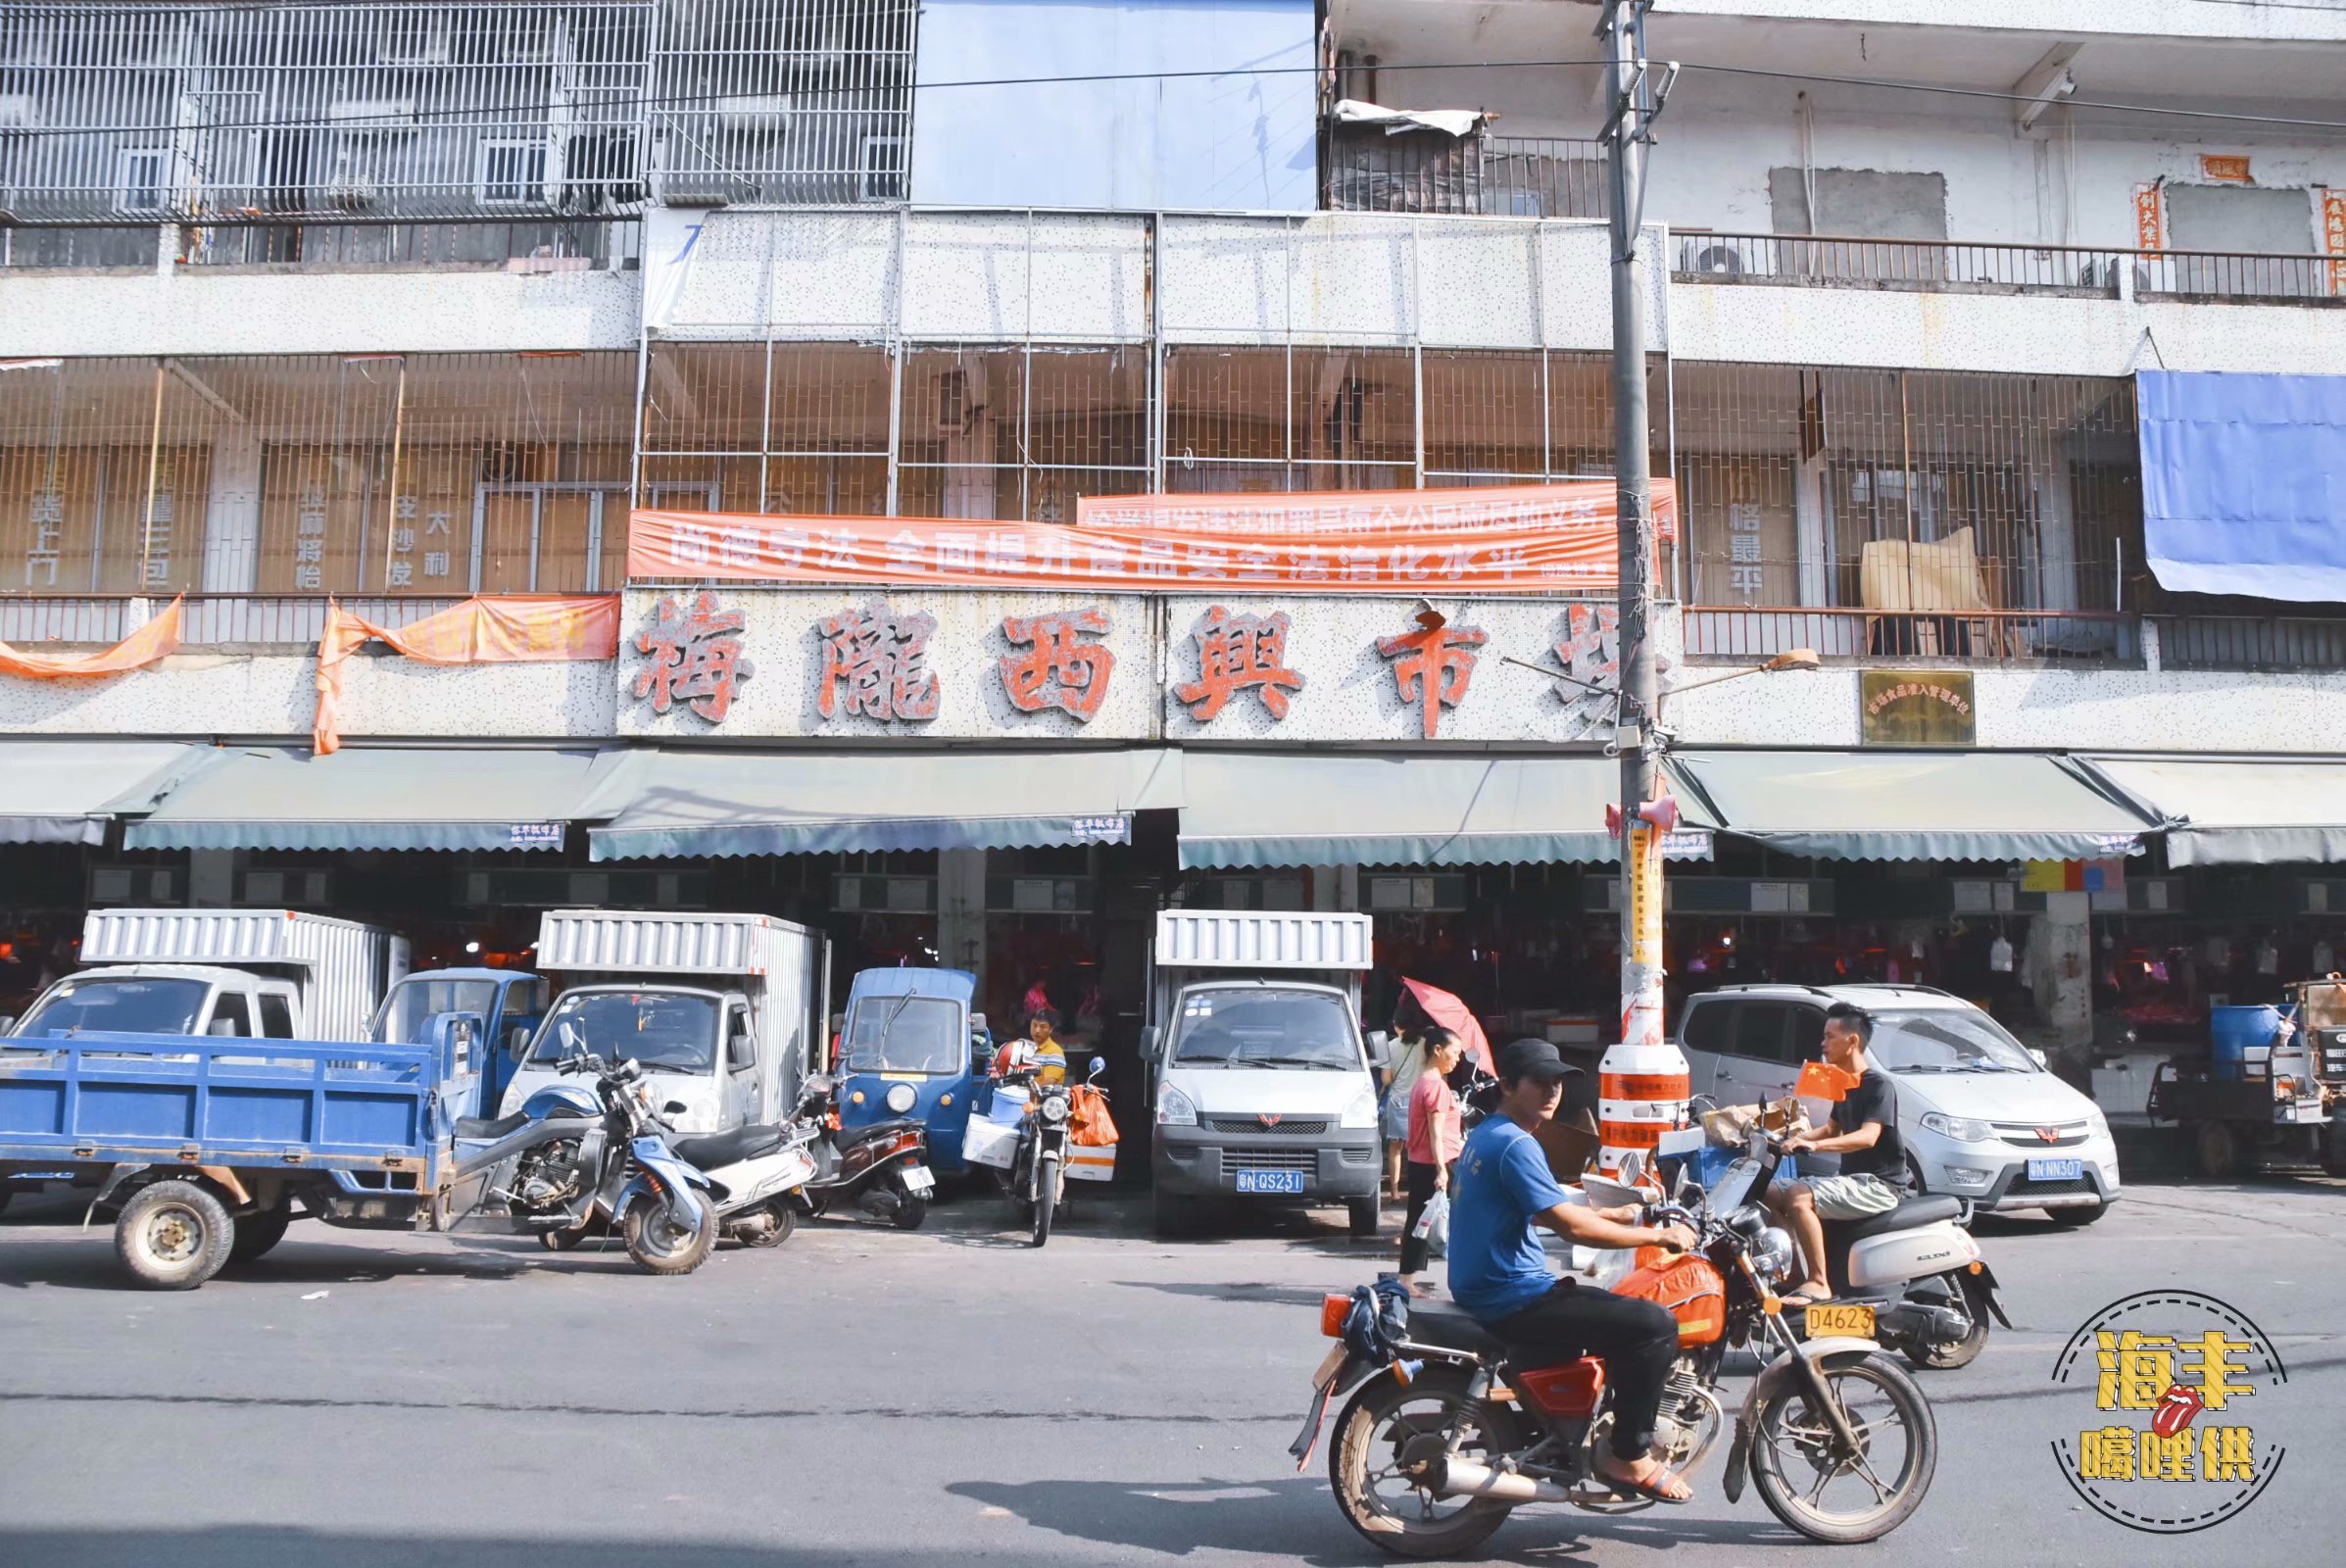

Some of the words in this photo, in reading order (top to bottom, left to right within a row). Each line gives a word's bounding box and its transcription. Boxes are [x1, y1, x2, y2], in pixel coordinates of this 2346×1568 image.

[669, 524, 860, 570] 尚德守法
[885, 529, 1529, 581] 全面提升食品安全法治化水平
[1809, 1308, 1873, 1330] D4623
